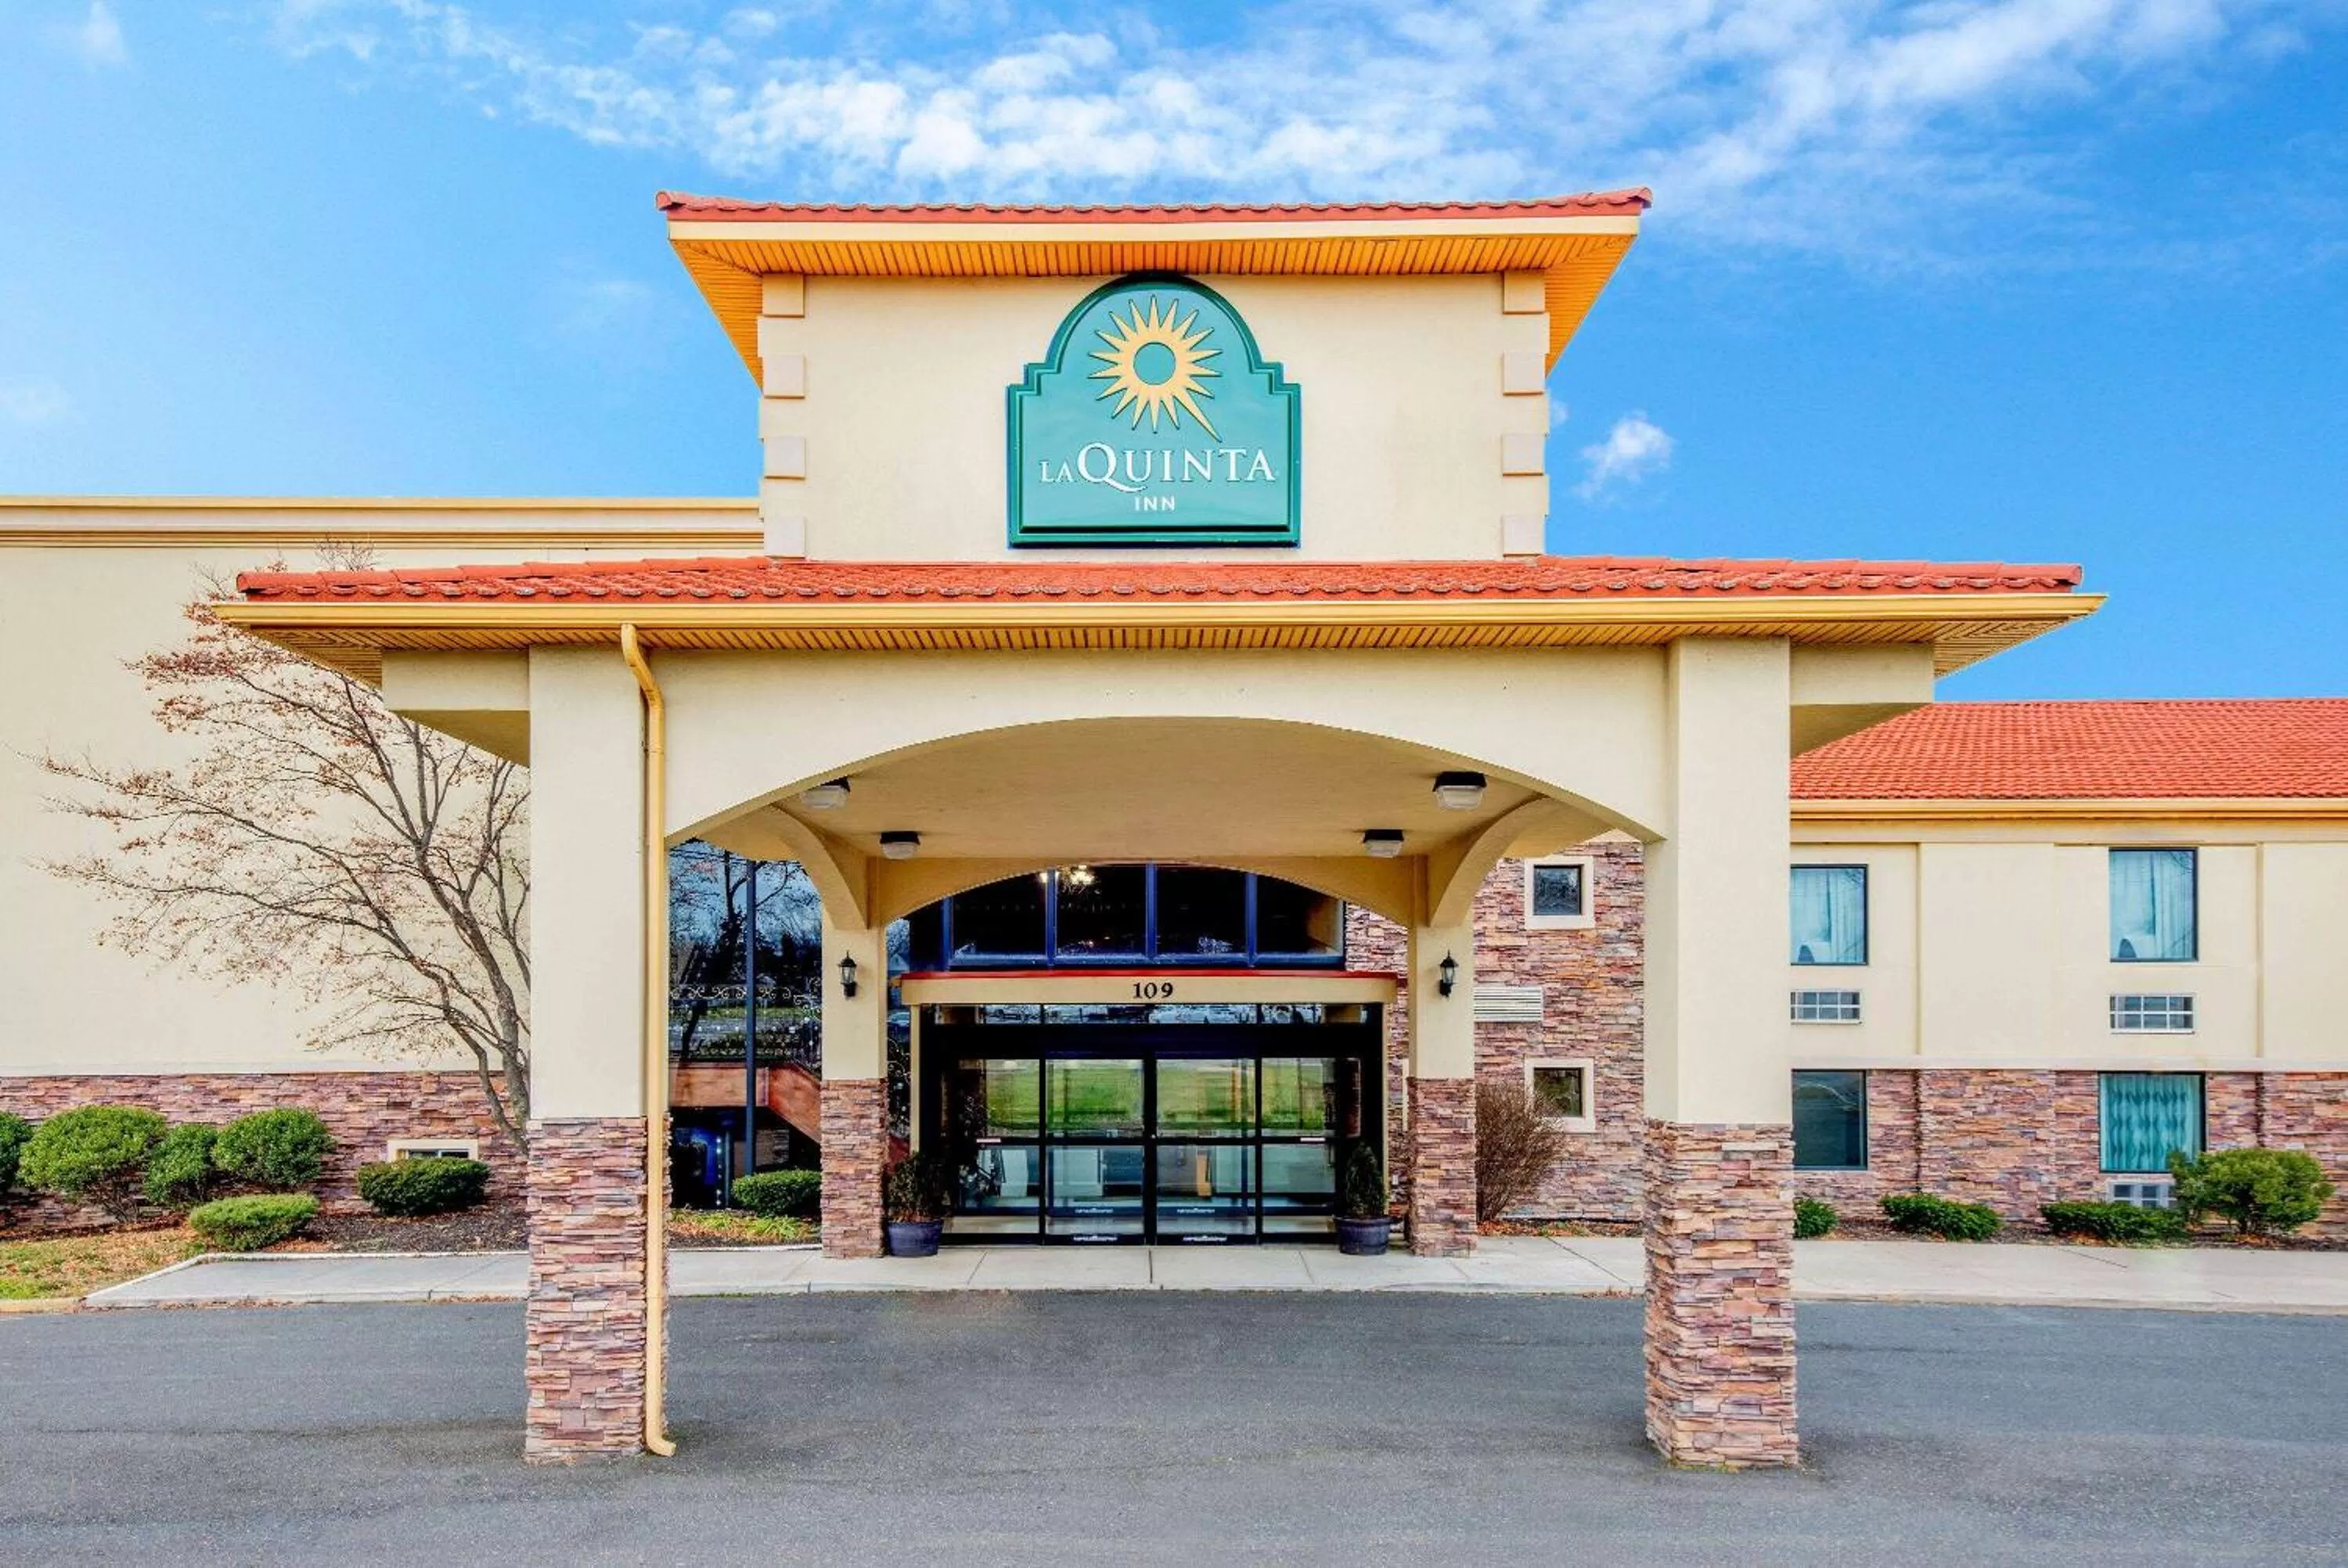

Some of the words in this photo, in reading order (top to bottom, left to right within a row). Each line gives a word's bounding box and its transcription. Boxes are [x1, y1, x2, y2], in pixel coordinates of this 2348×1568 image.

[1039, 459, 1075, 483] LA
[1077, 442, 1277, 493] QUINTA
[1134, 496, 1175, 511] INN
[1133, 982, 1173, 999] 109
